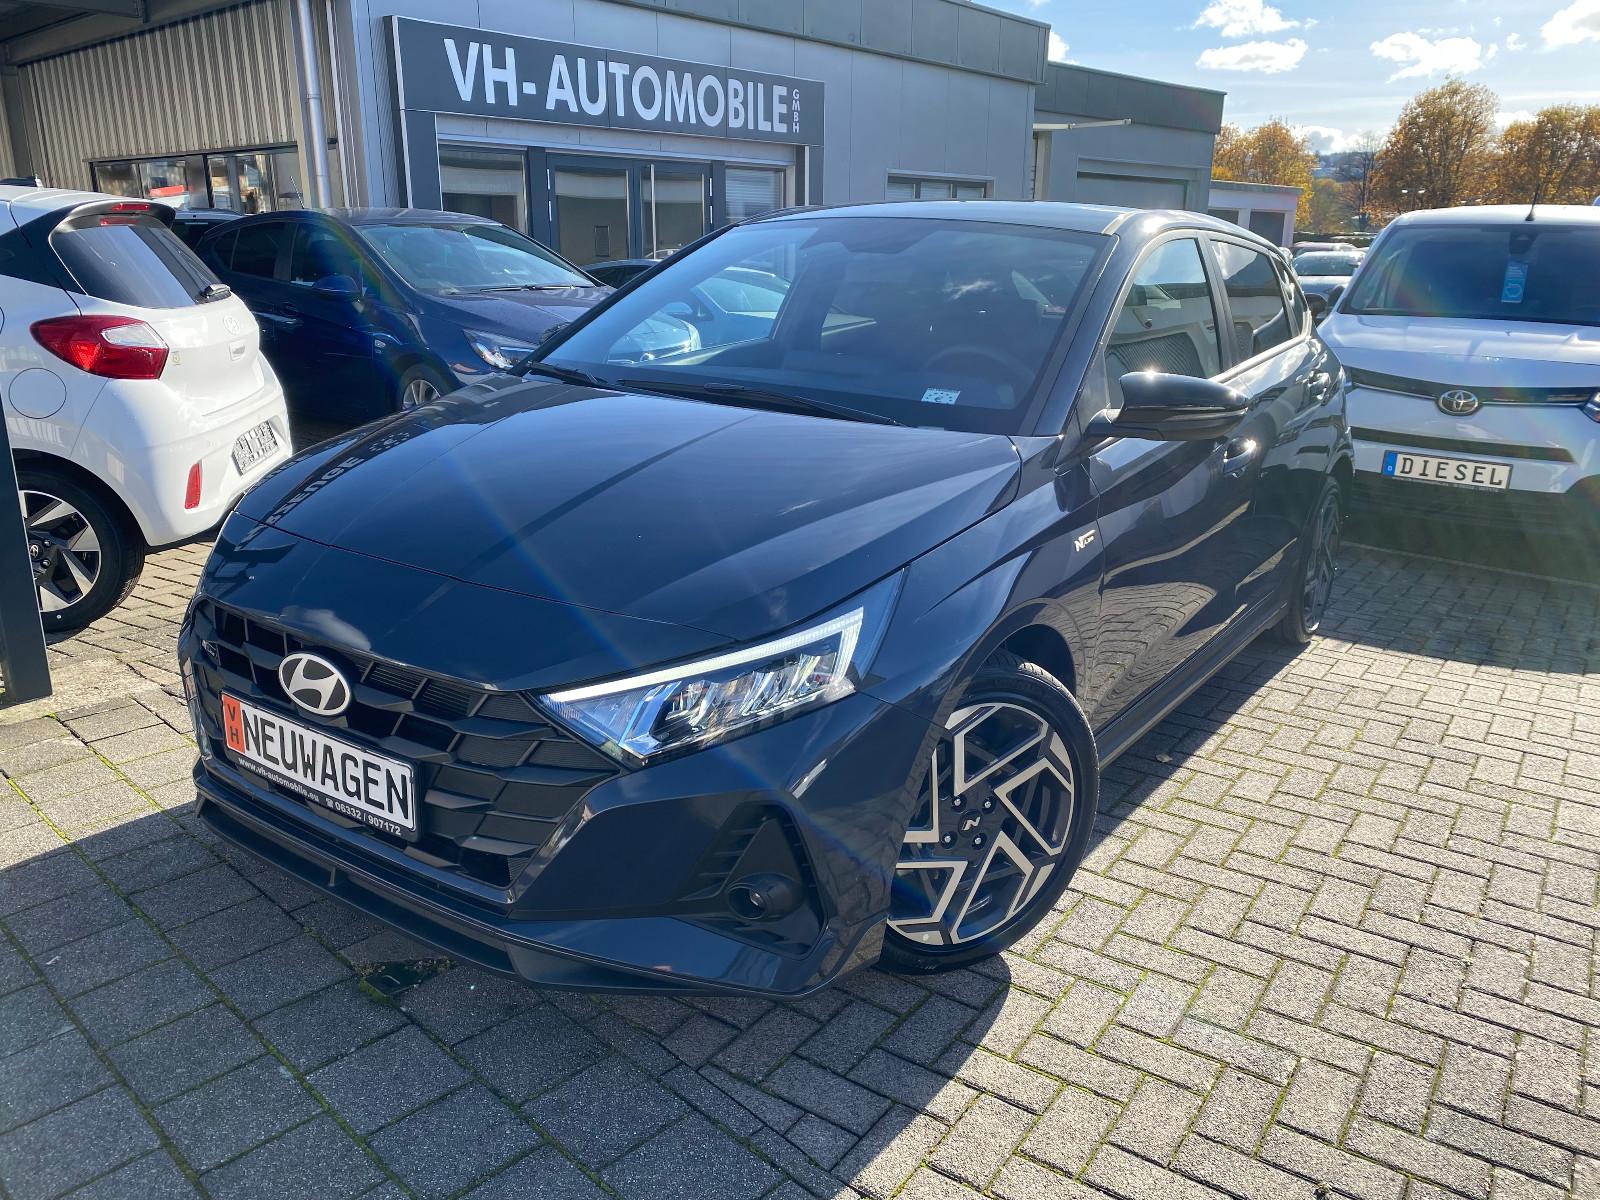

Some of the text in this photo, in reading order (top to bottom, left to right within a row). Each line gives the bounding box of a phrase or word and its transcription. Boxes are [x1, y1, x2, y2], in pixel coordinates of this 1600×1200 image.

[1400, 457, 1503, 486] DIESEL
[238, 757, 321, 801] www.vh-automobile.eu
[334, 801, 362, 820] 06332
[367, 815, 402, 836] 907172
[242, 709, 409, 820] NEUWAGEN
